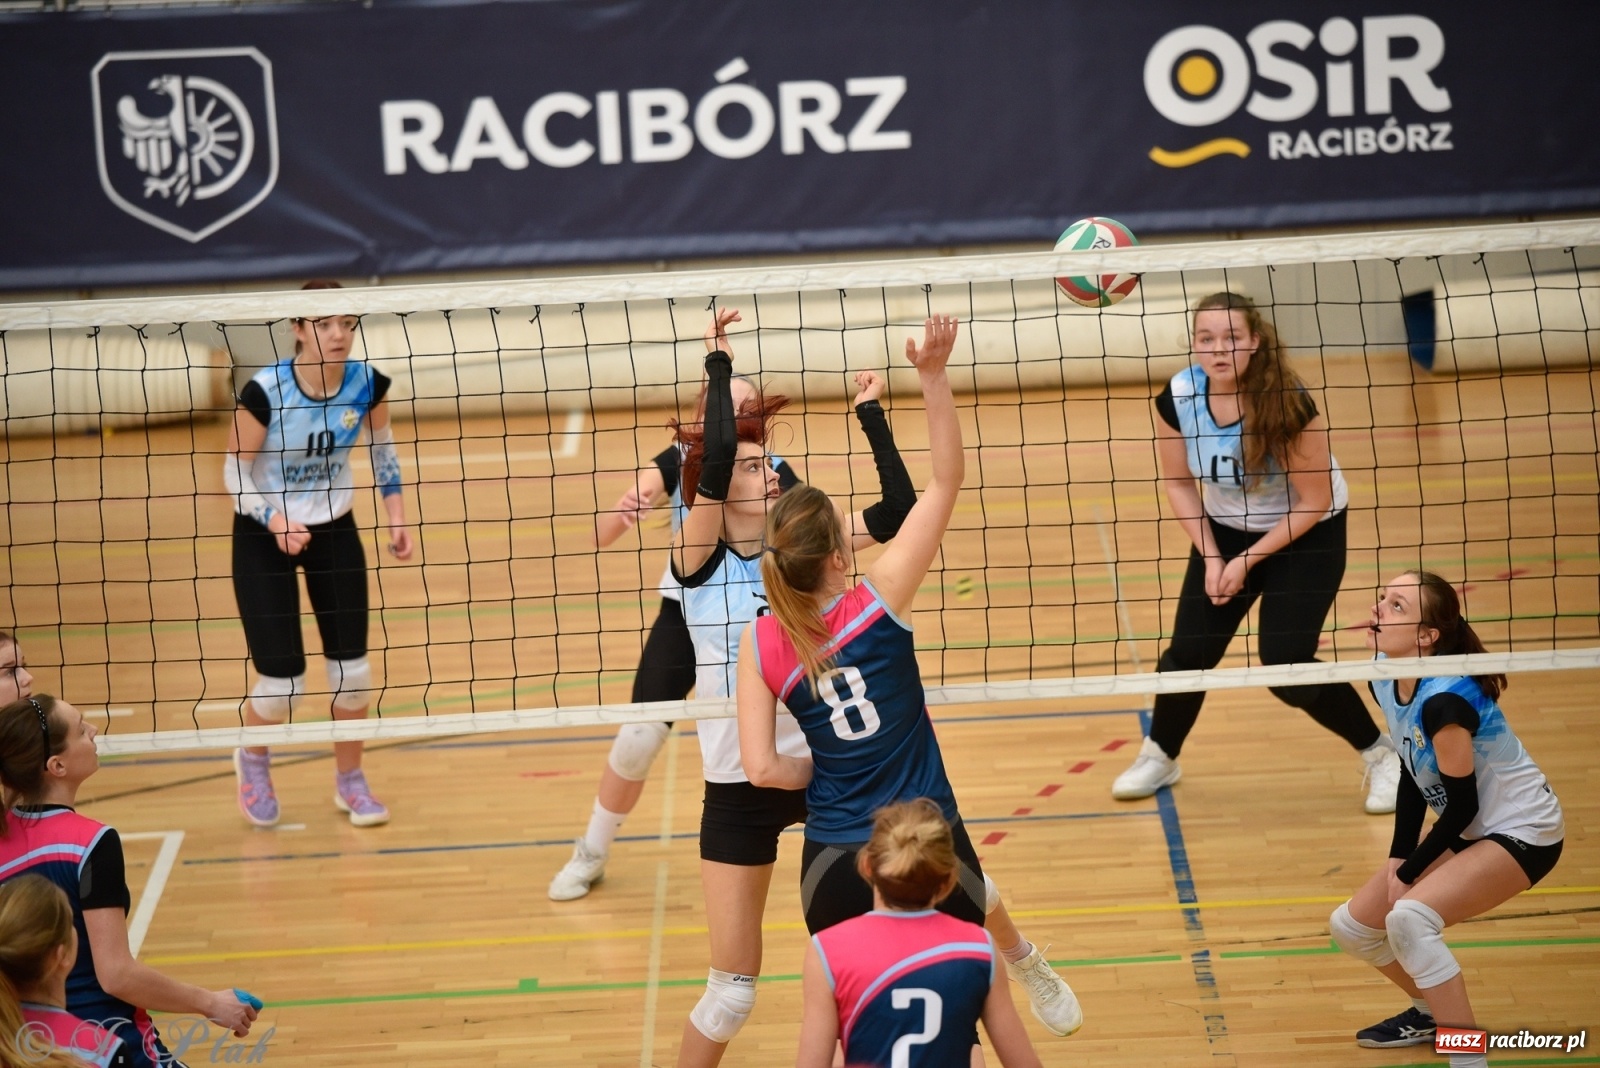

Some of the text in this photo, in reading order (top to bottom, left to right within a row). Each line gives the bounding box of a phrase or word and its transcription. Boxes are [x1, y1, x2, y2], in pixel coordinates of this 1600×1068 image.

[1143, 14, 1452, 127] OSiR
[380, 58, 911, 175] RACIBÓRZ
[1268, 116, 1453, 160] RACIBÓRZ
[305, 430, 335, 458] 10
[1211, 454, 1241, 486] 17
[818, 666, 881, 741] 8
[1402, 735, 1417, 777] 7
[891, 988, 943, 1068] 2
